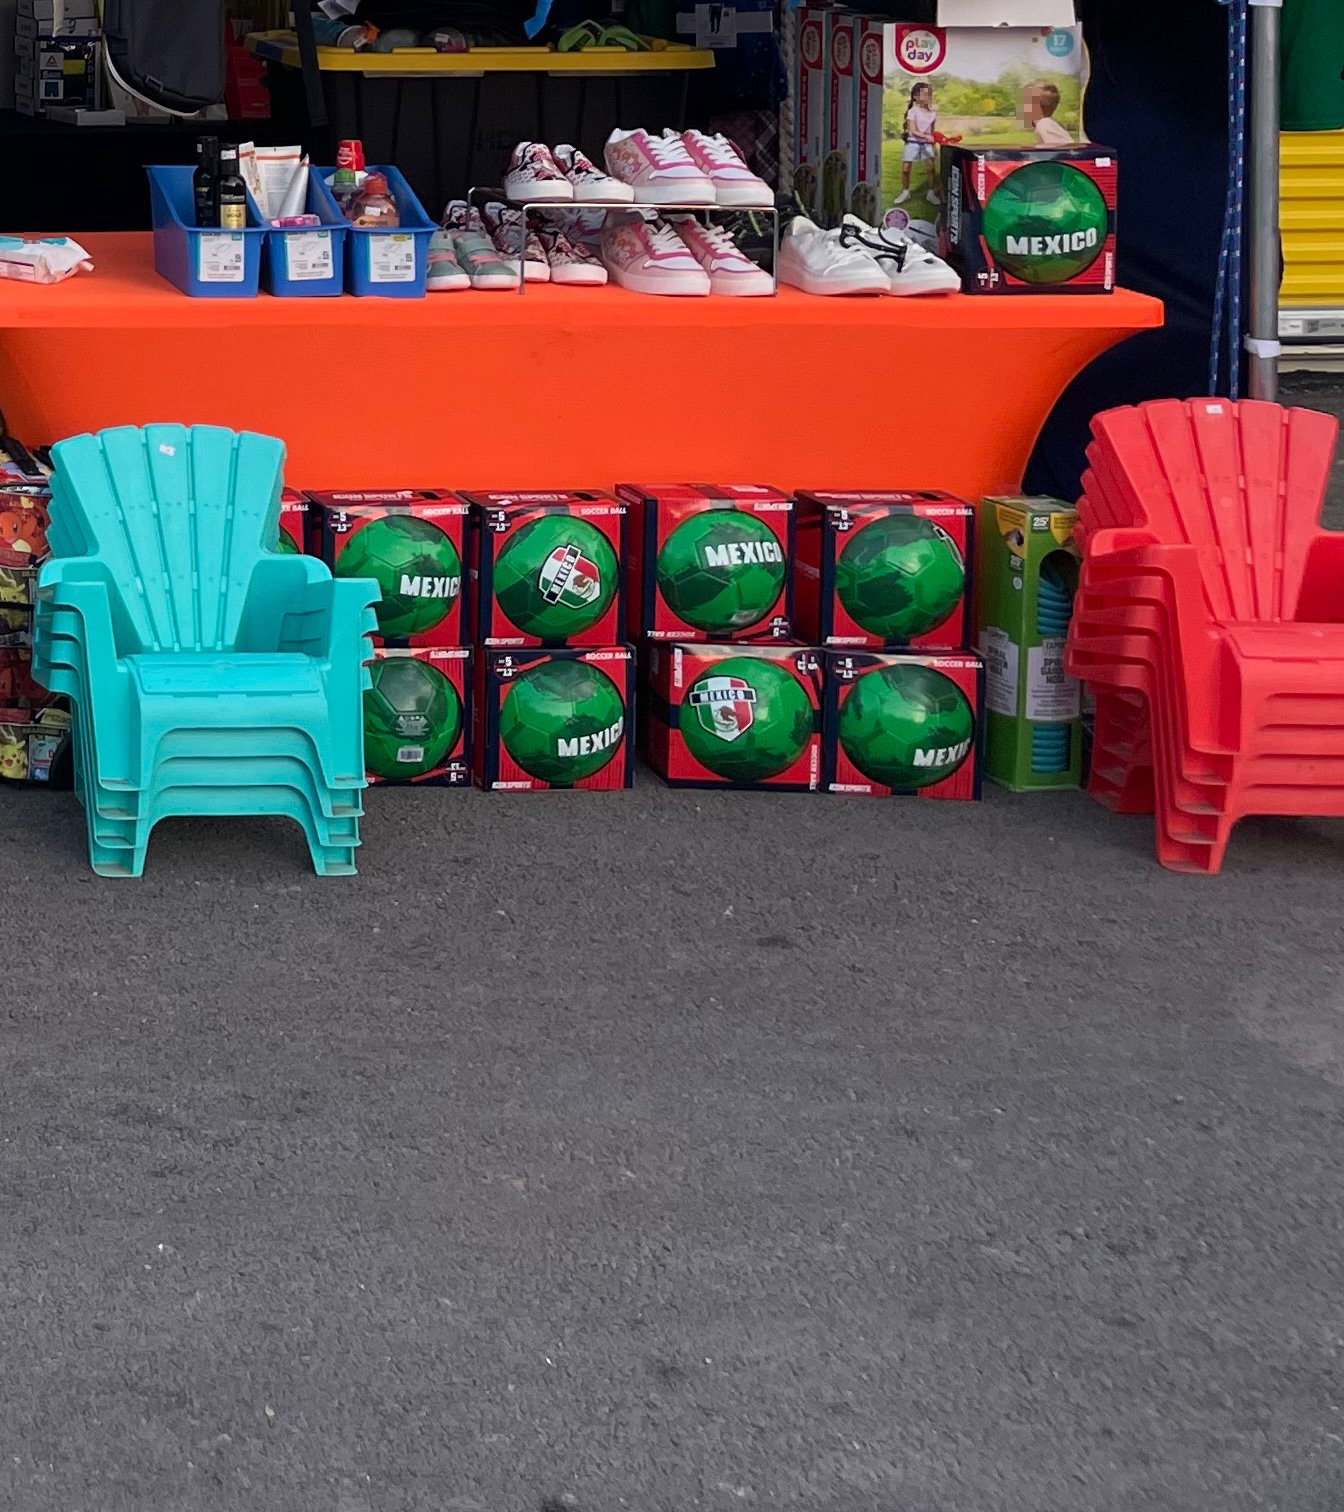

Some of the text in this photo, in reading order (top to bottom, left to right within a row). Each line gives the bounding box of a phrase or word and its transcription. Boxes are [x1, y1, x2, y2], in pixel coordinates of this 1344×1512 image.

[906, 37, 936, 51] play
[907, 49, 933, 62] day
[1007, 227, 1097, 255] MEXICO
[581, 507, 608, 515] SOCCER
[705, 542, 782, 567] MEXICO
[400, 574, 462, 598] MEXIC
[551, 554, 576, 594] MEXICO
[934, 660, 983, 669] SOCCER BALL
[700, 690, 744, 702] MEXICO
[558, 717, 624, 757] MEXIC
[913, 738, 971, 767] MEXI
